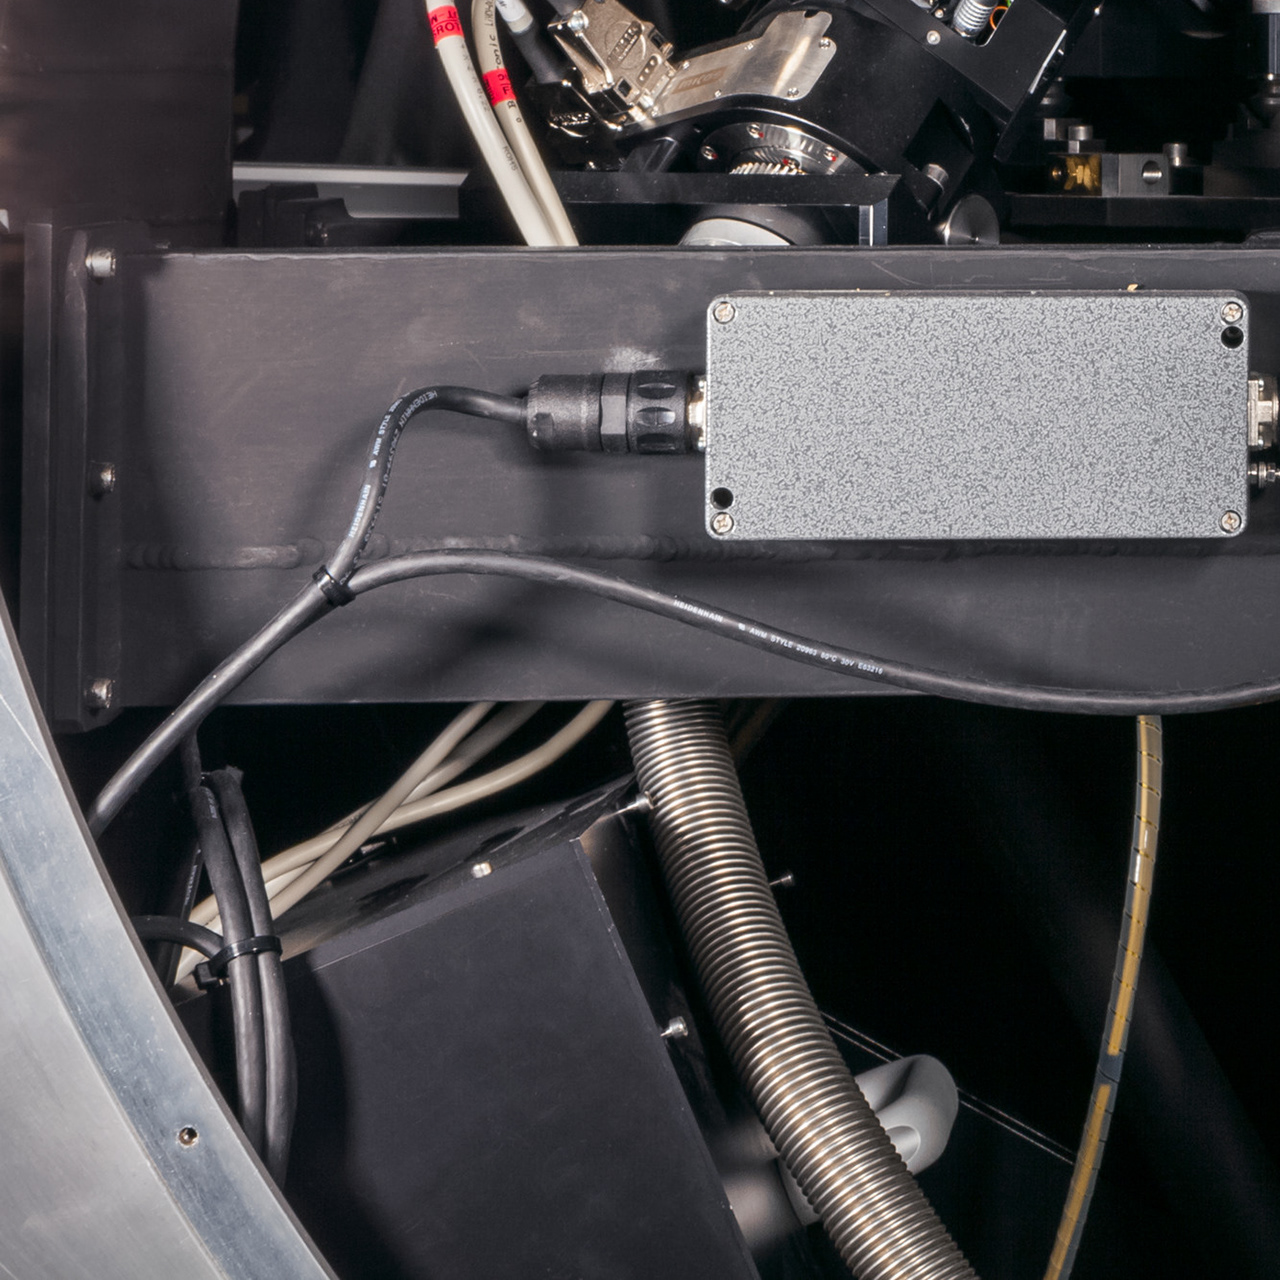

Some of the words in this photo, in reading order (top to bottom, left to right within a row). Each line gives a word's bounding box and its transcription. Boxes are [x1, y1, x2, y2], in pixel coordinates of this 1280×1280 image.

[348, 484, 372, 538] HEIDENHAIN
[372, 437, 383, 456] AWM
[672, 599, 724, 623] HEIDENHAIN
[749, 627, 768, 639] AWM
[770, 635, 794, 648] STYLE
[840, 657, 855, 668] 30V
